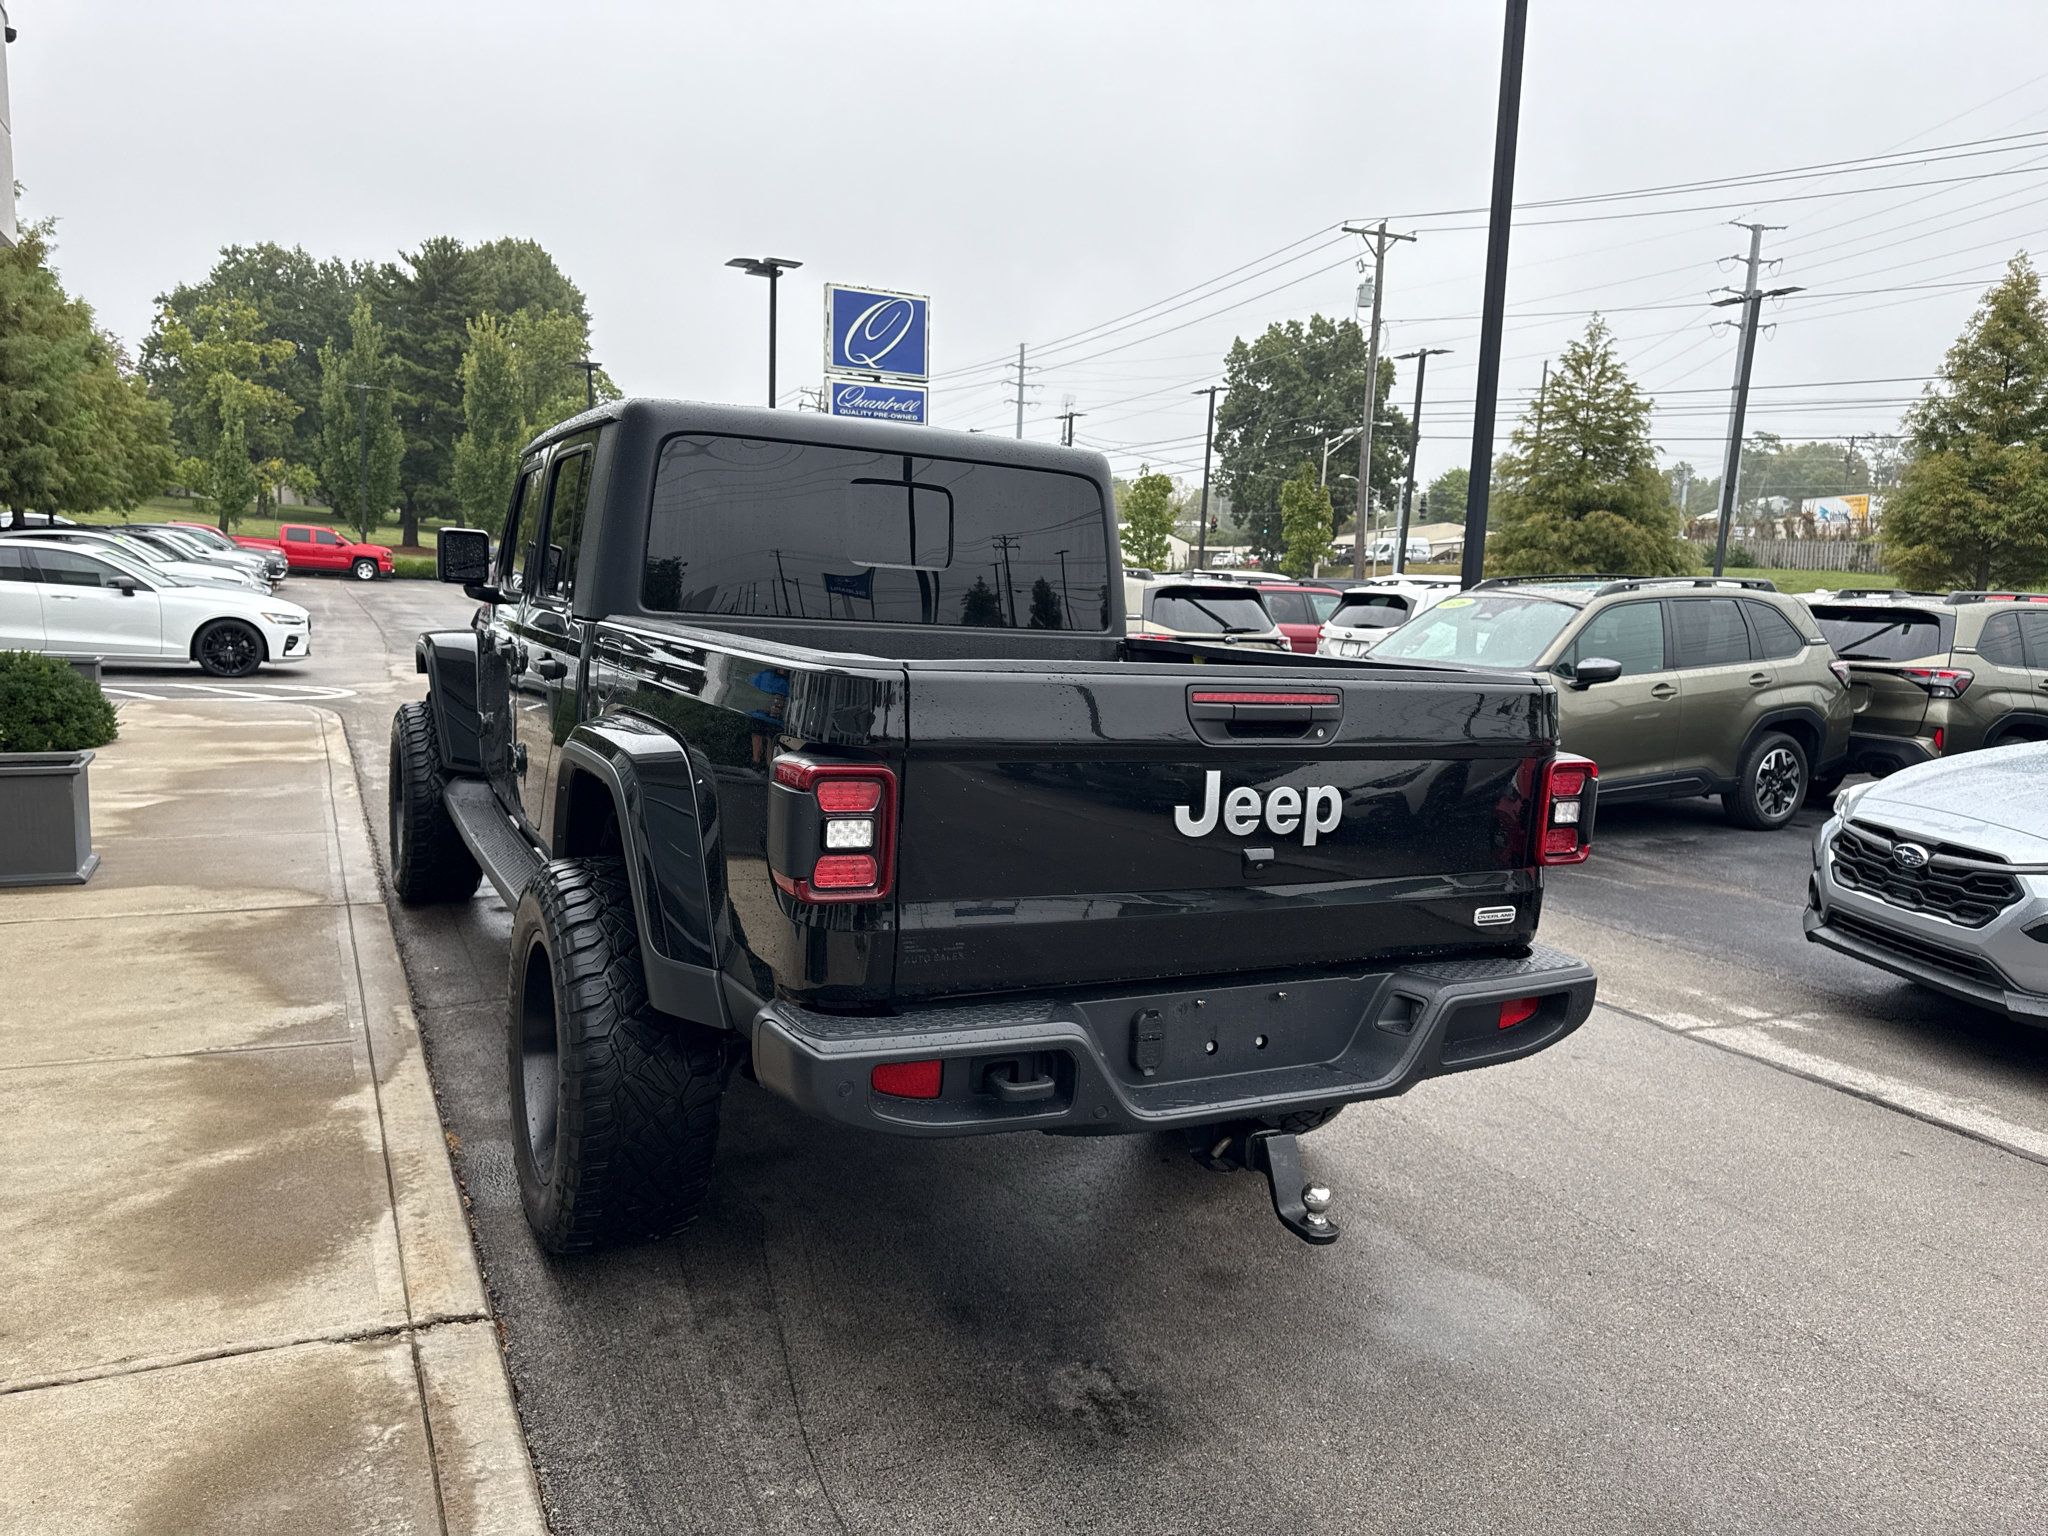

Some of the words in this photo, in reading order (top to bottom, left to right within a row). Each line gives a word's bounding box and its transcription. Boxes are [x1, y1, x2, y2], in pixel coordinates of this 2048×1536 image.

[836, 385, 921, 413] Quantrell
[839, 408, 872, 417] QUALITY
[873, 411, 919, 421] PRE-OWNED
[1174, 770, 1343, 847] Jeep
[1477, 912, 1515, 920] OVERLAND
